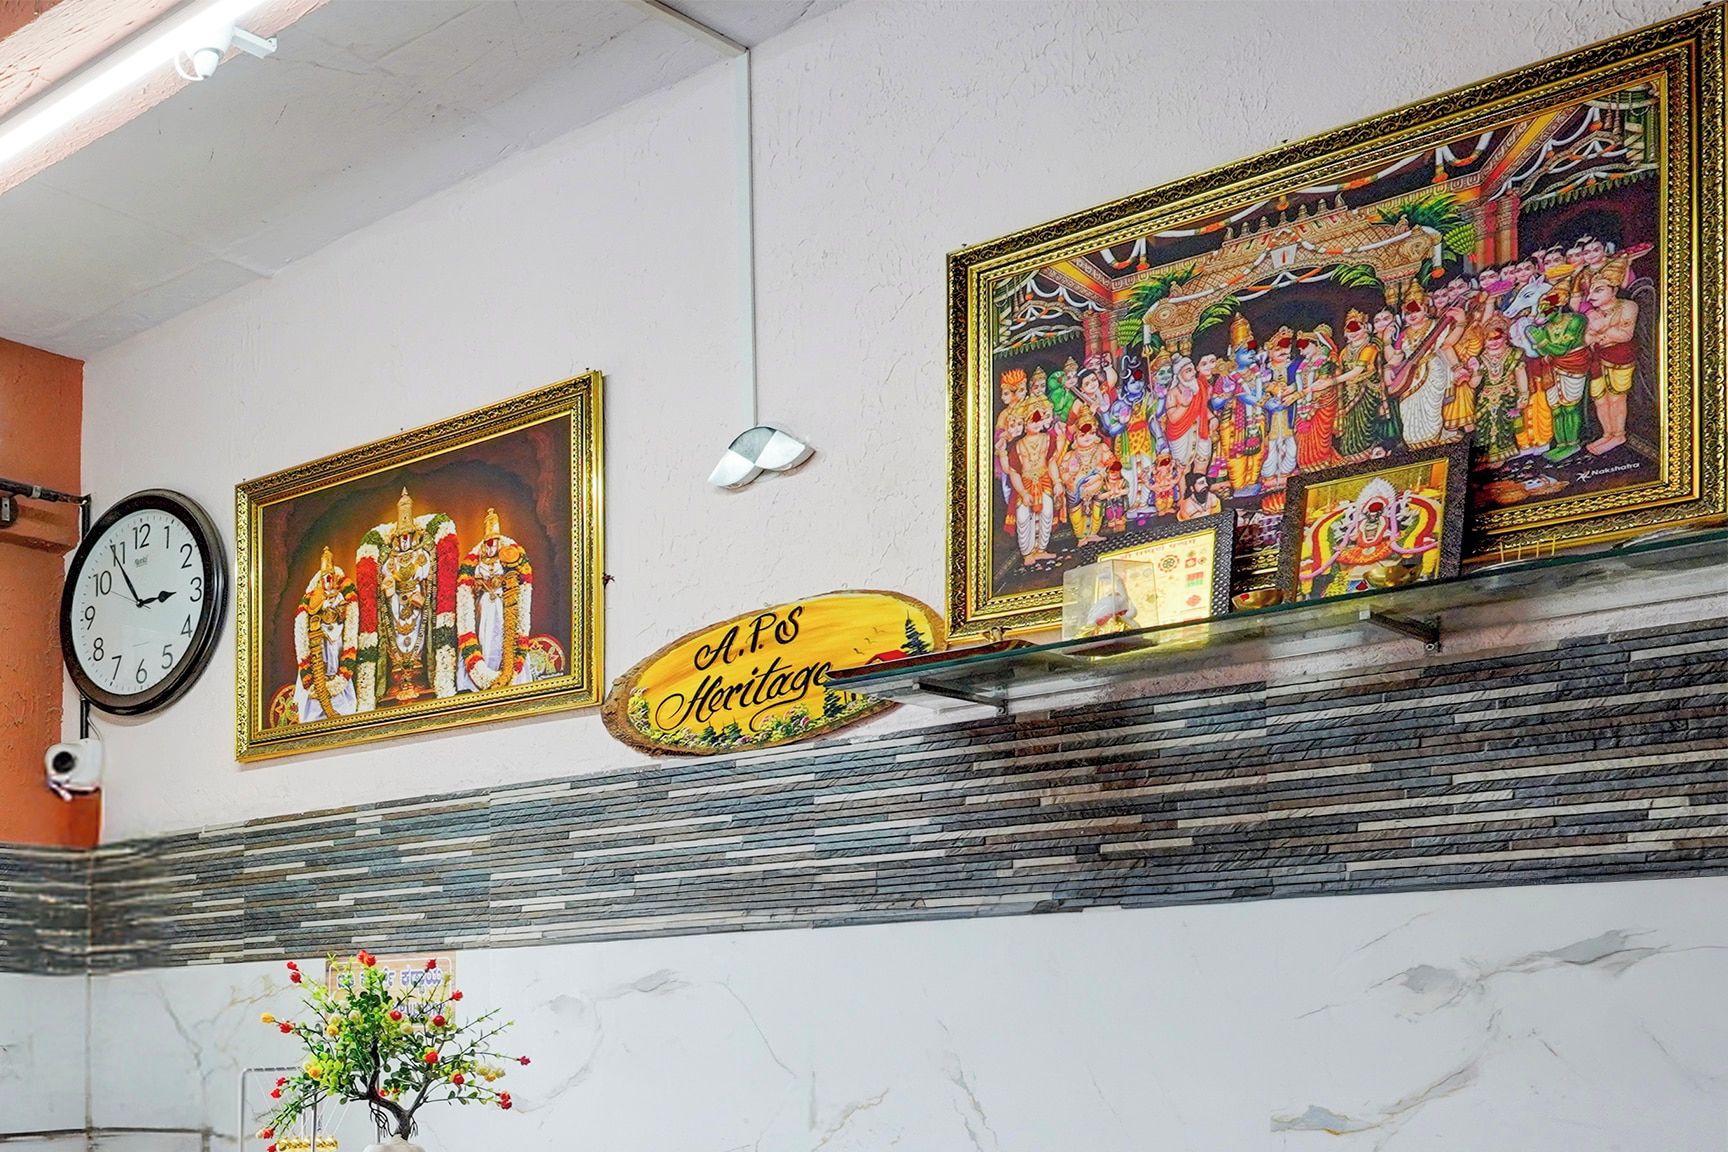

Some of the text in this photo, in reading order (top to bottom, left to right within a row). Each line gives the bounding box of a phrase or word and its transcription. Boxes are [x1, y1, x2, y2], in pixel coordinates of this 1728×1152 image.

[1591, 462, 1640, 476] Nakshatra
[132, 523, 151, 549] 12
[163, 525, 170, 549] 1
[180, 543, 193, 569] 2
[93, 569, 112, 597] 10
[190, 577, 202, 602] 3
[84, 606, 96, 630] 9
[180, 614, 192, 638] 4
[93, 637, 105, 661] 8
[161, 644, 174, 669] 5
[111, 655, 122, 681] 7
[135, 659, 147, 684] 6
[655, 656, 833, 733] Heritage
